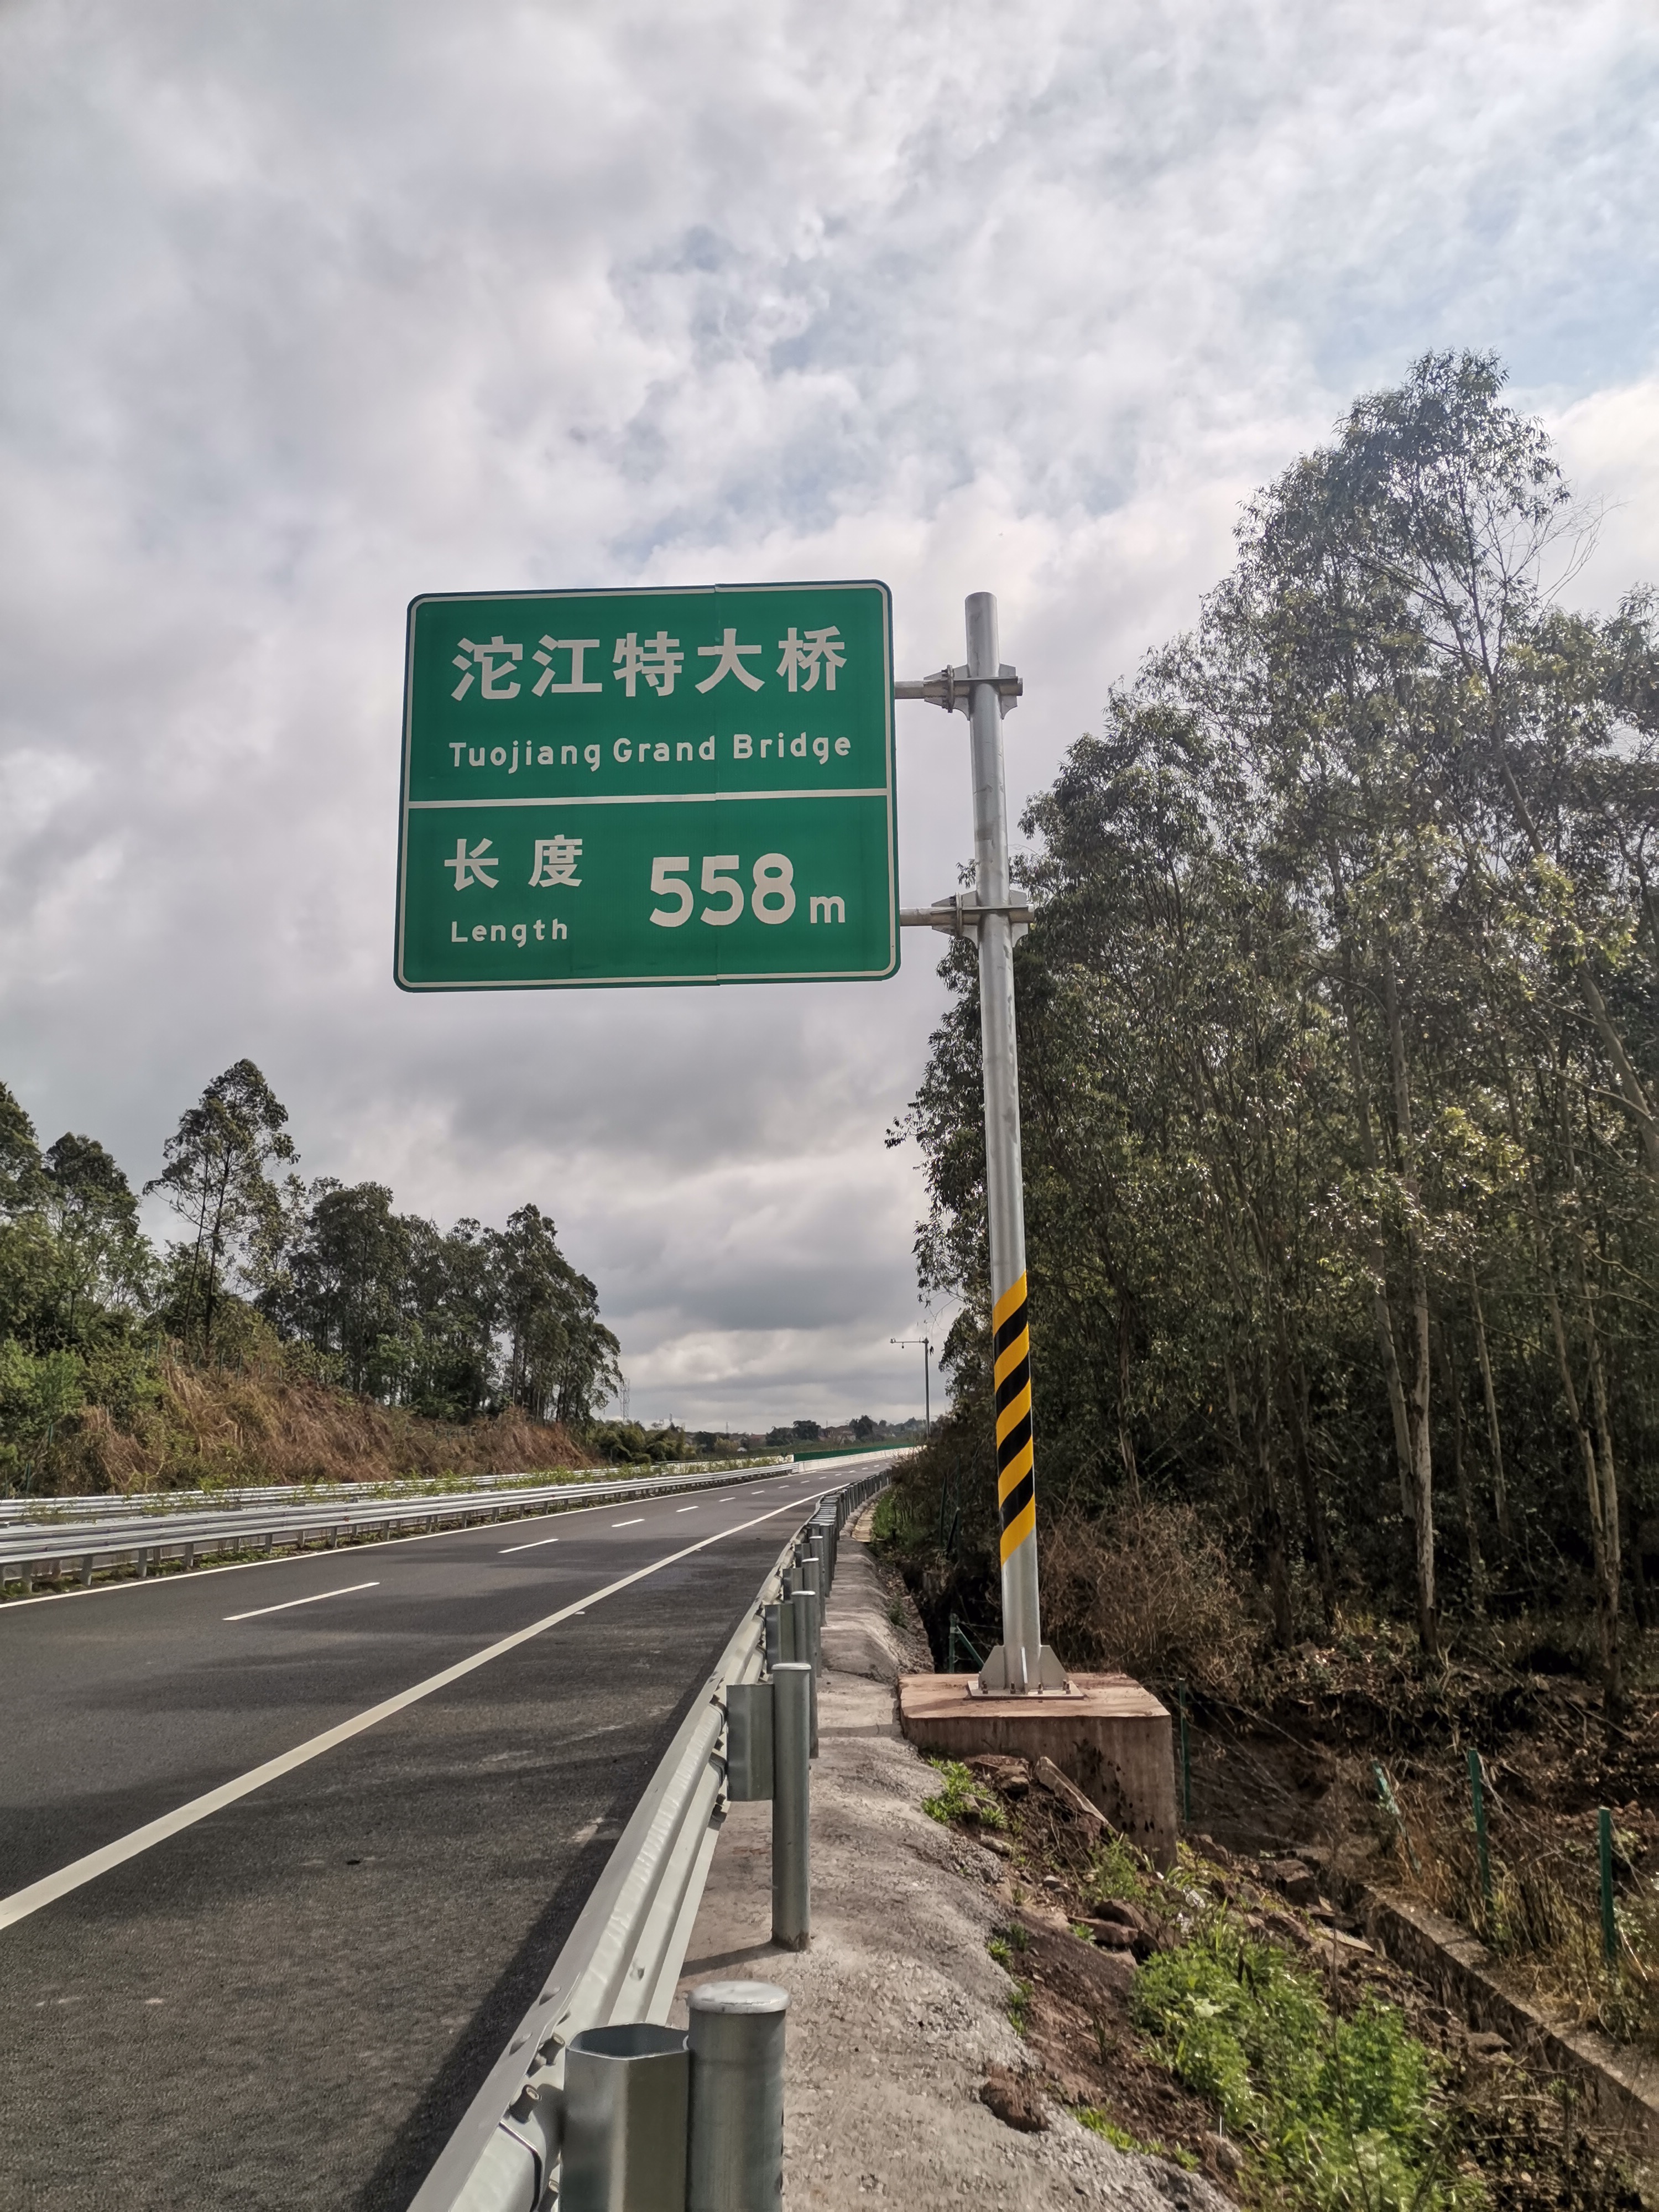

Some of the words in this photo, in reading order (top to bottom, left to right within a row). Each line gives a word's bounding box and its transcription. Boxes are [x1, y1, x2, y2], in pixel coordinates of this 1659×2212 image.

[451, 625, 847, 701] 沱江特大桥
[449, 739, 601, 774] Tuojiang
[613, 735, 716, 763] Grand
[733, 731, 852, 765] Bridge
[451, 919, 568, 948] Length
